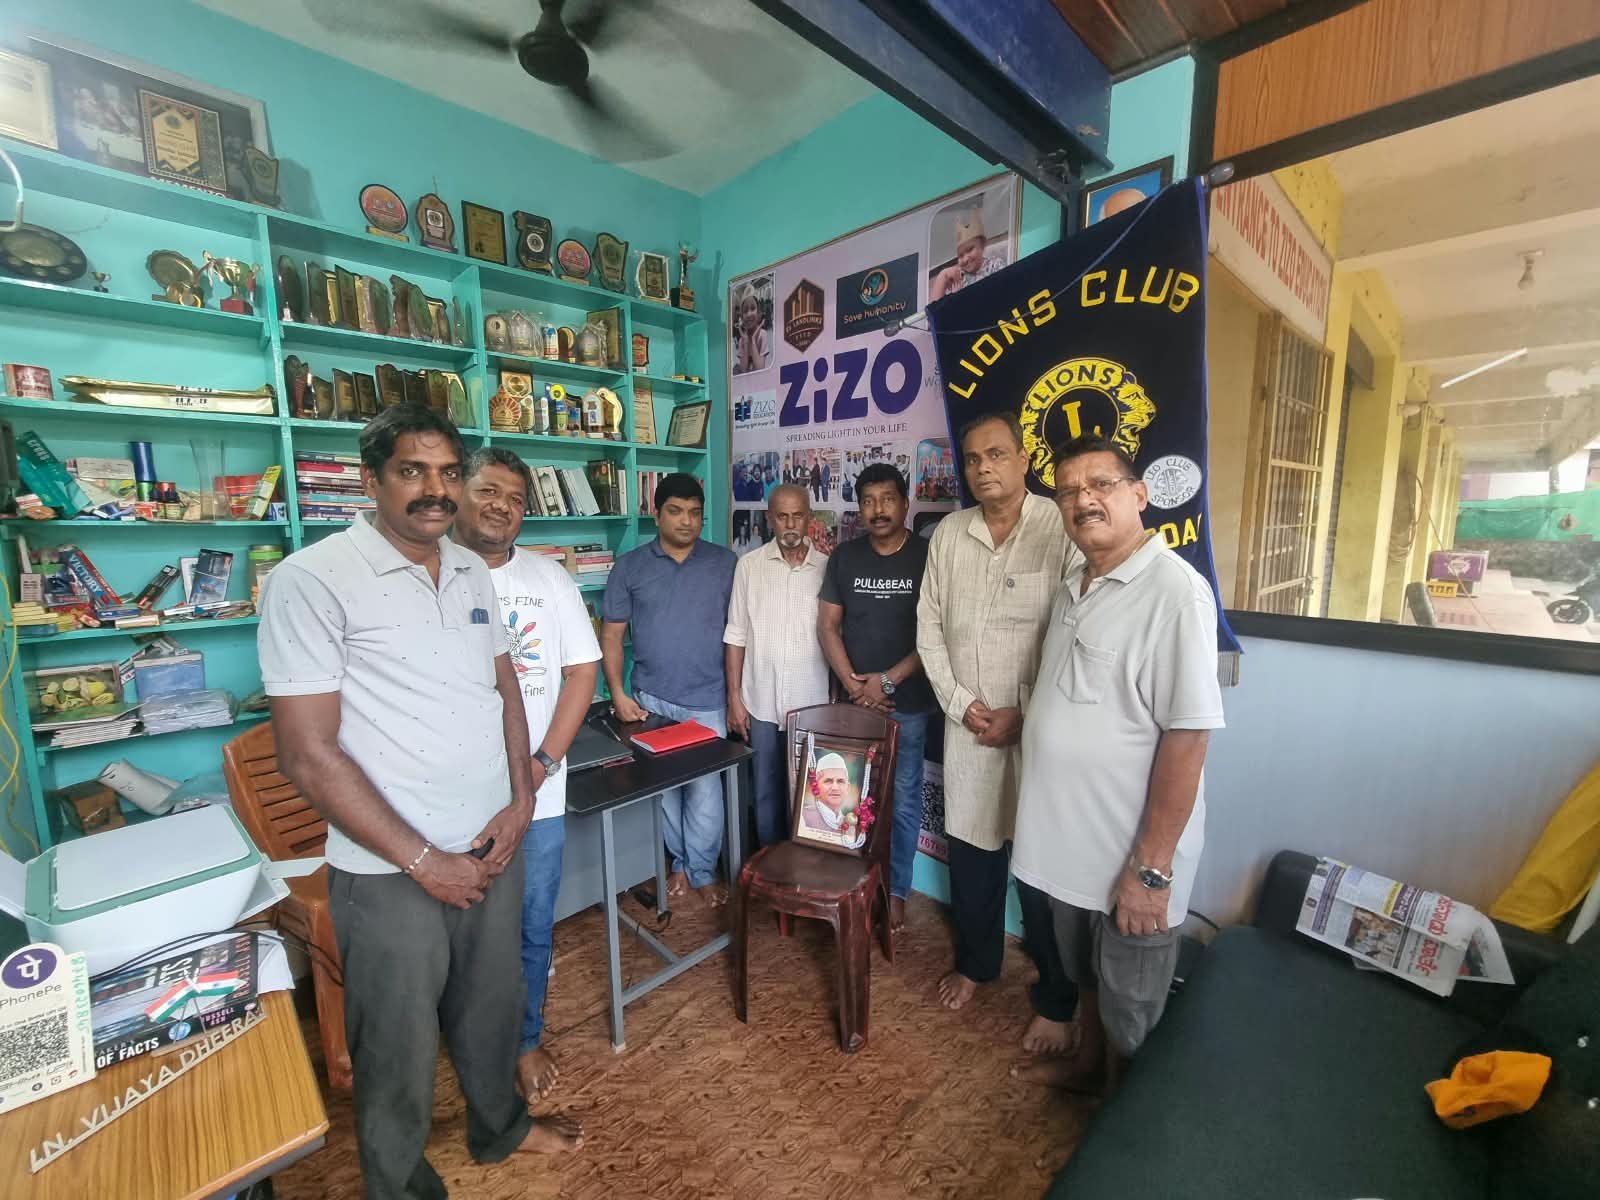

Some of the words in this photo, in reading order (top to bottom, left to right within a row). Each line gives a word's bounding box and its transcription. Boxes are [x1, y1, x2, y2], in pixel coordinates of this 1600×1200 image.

[843, 312, 863, 325] Save
[949, 288, 1057, 400] LIONS
[1080, 265, 1200, 313] CLUB
[1032, 364, 1116, 404] LIONS
[786, 431, 826, 443] SPREADING
[827, 428, 852, 440] LIGHT
[852, 427, 861, 437] IN
[863, 424, 886, 436] YOUR
[888, 422, 908, 433] LIFE
[1146, 463, 1161, 480] LEO
[1166, 458, 1192, 472] CLUB
[1151, 486, 1196, 506] SPONSOR
[69, 554, 102, 595] VICTORY
[853, 577, 913, 590] PULL&BEAR
[515, 596, 545, 608] FINE
[524, 683, 545, 697] fine
[97, 1052, 114, 1069] OF
[119, 1037, 159, 1061] FACTS
[80, 1065, 176, 1129] VIJAYA
[179, 999, 267, 1069] DHEERAJ
